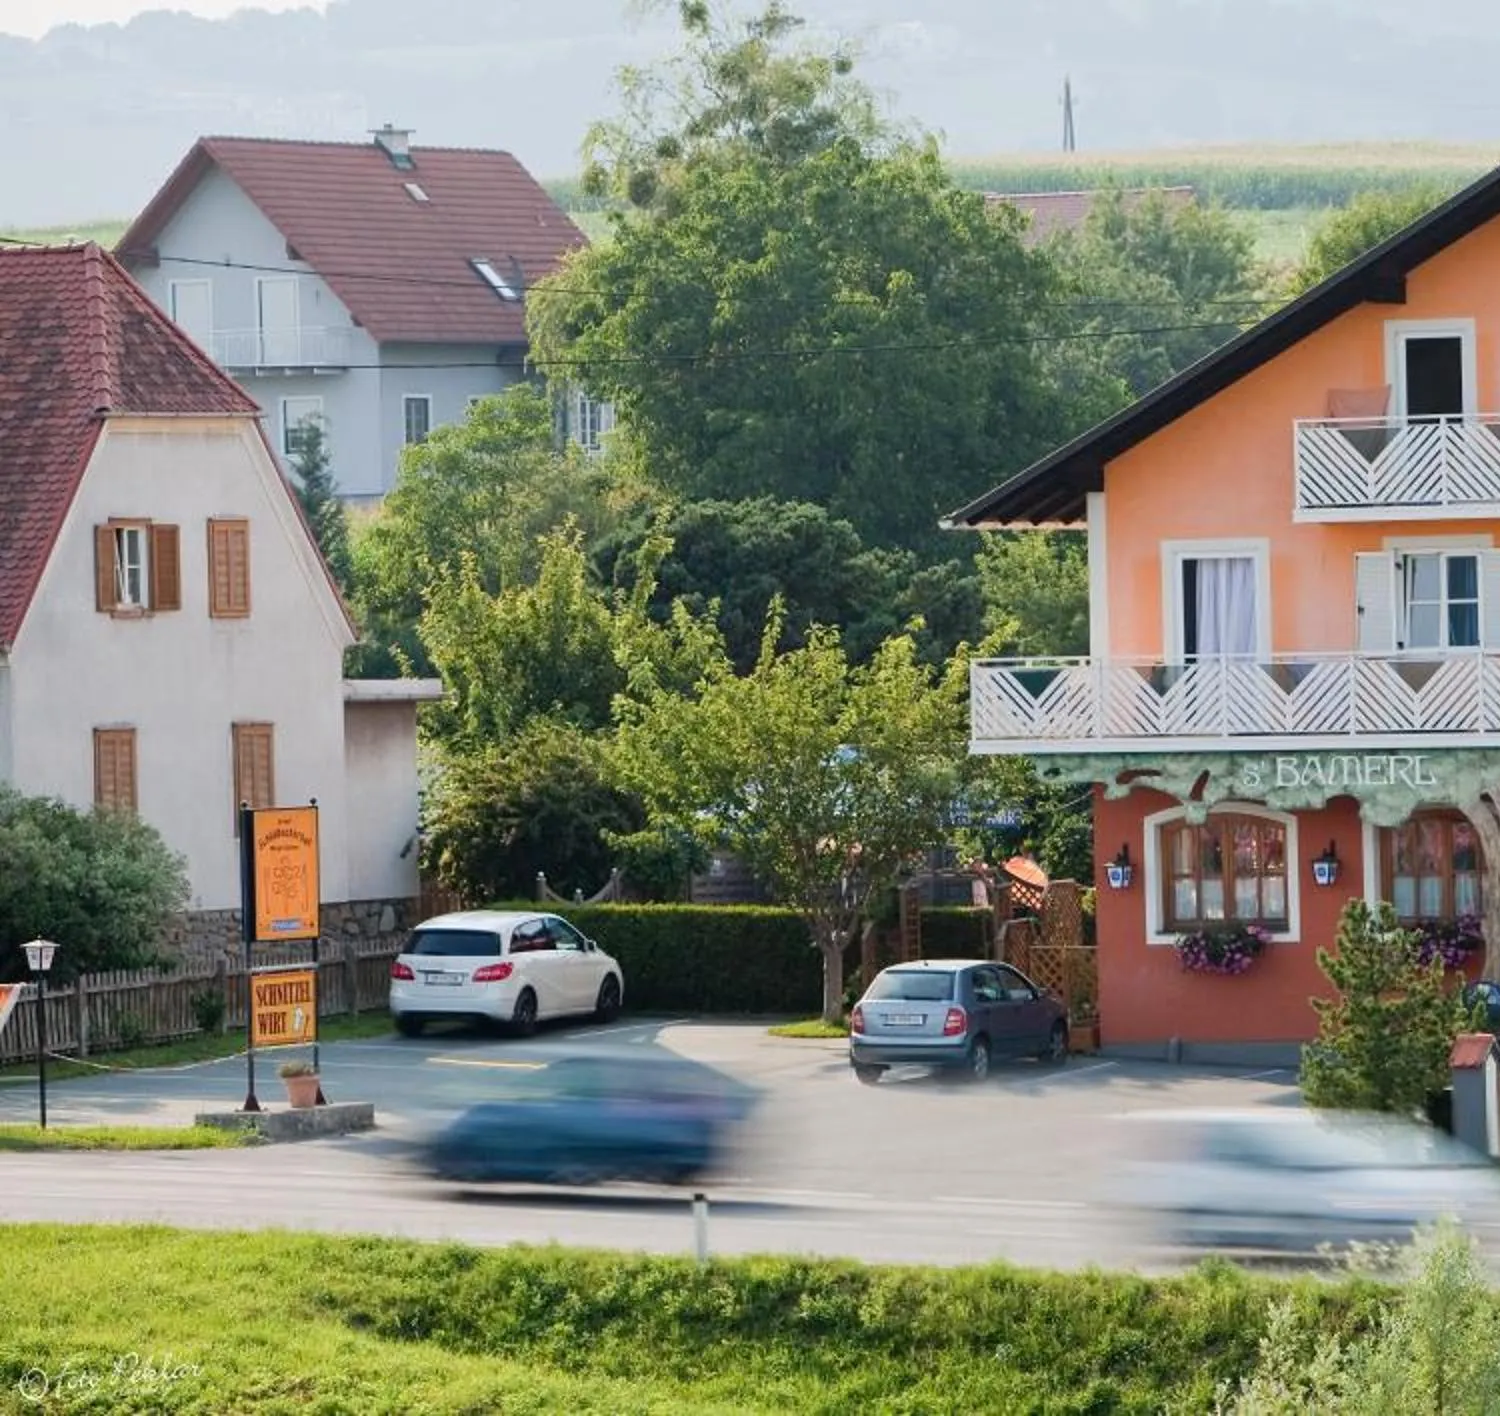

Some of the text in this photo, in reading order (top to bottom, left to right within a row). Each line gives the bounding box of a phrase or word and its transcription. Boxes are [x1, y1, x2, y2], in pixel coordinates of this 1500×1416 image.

[1275, 755, 1437, 789] BAMERL
[255, 981, 311, 1007] SCHNITZEL
[257, 1011, 287, 1035] WIRT
